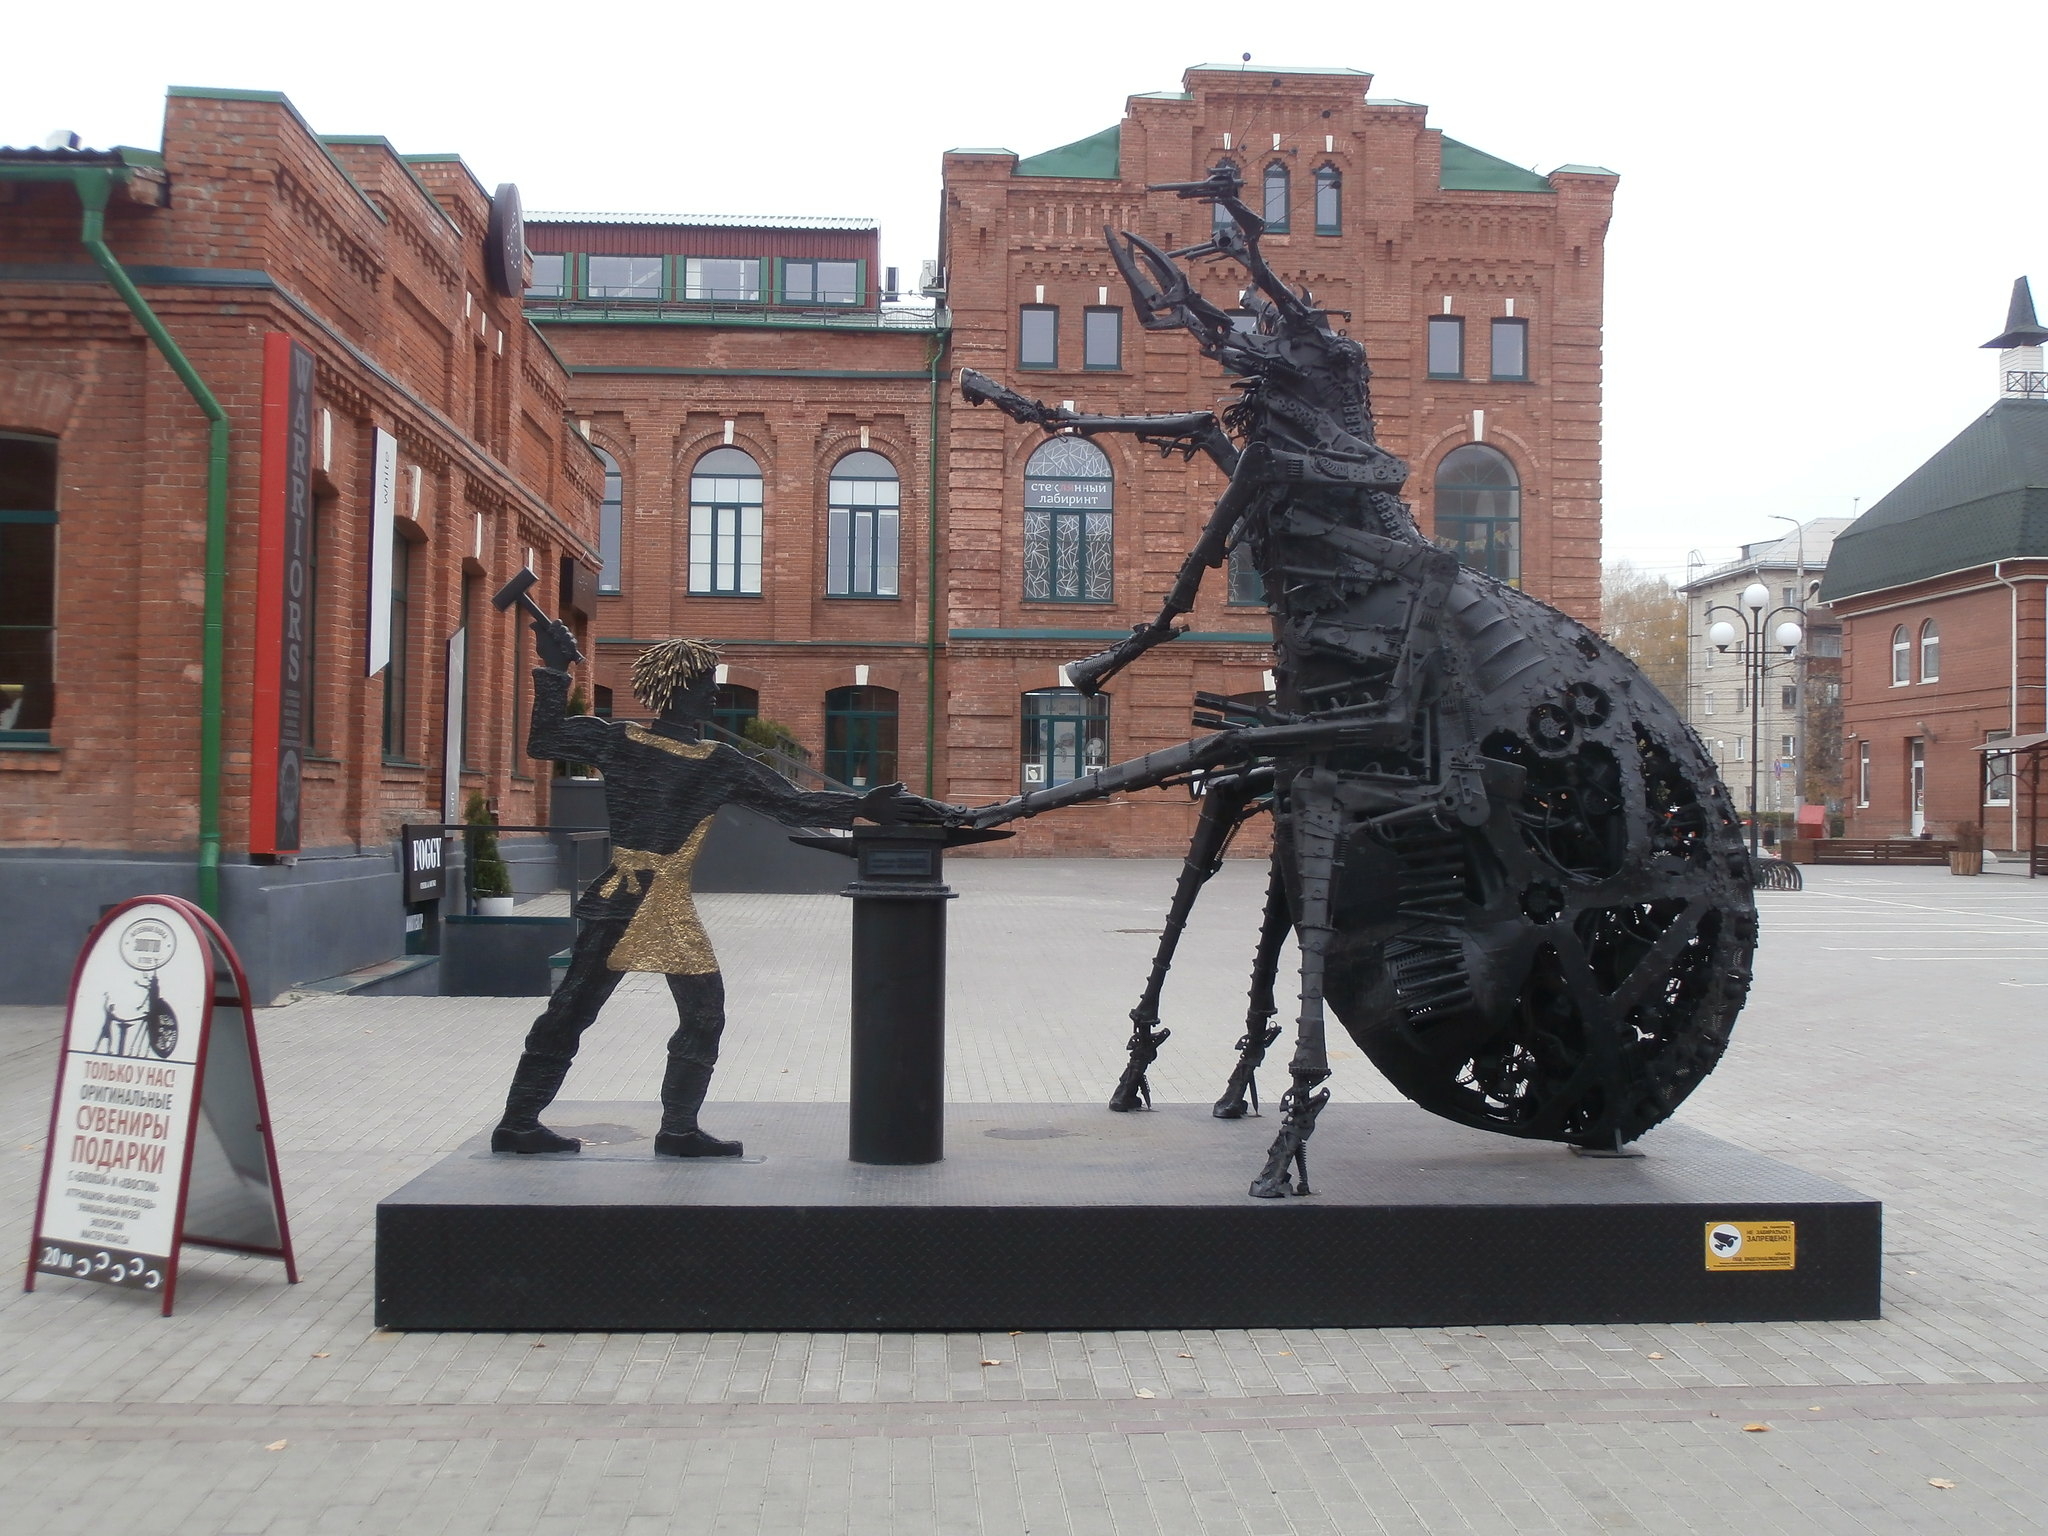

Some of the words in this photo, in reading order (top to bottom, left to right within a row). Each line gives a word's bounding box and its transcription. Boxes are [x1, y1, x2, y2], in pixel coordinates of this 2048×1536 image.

[288, 348, 312, 682] WARRIORS
[1039, 493, 1099, 506] лабиринт
[412, 837, 442, 872] FOGGY
[85, 1061, 133, 1083] ТОЛЬКО
[134, 1065, 145, 1085] У
[145, 1066, 176, 1088] НАС!
[81, 1084, 173, 1110] ОРИГИНАЛЬНЫЕ
[76, 1104, 170, 1140] СУВЕНИРЫ
[71, 1134, 166, 1175] ПОДАРКИ
[42, 1246, 60, 1266] 20
